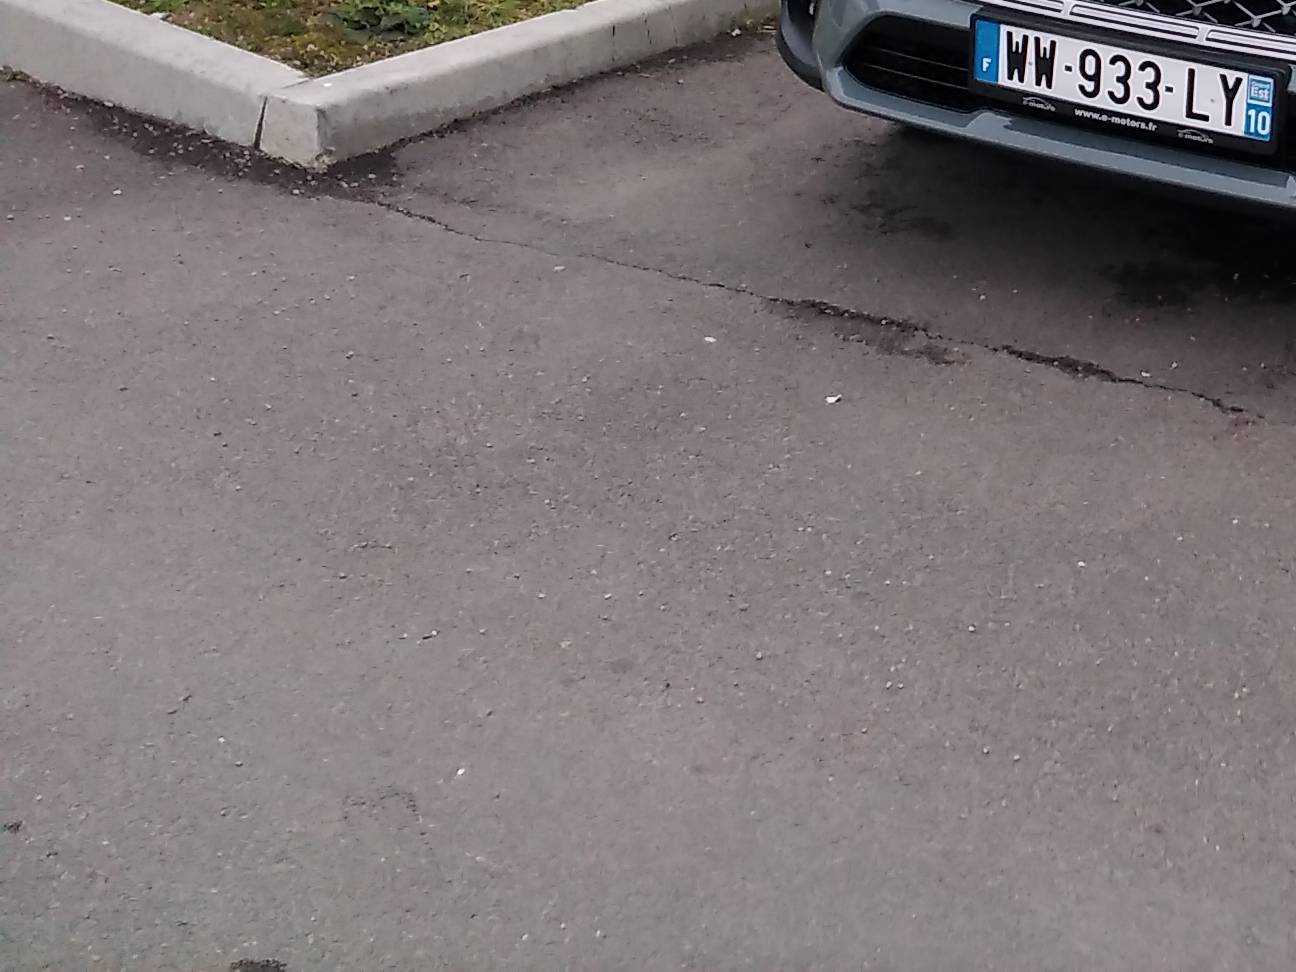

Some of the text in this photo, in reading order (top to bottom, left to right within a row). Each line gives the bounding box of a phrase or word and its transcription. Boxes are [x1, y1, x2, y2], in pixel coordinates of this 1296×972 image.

[982, 57, 992, 72] F
[1005, 30, 1244, 127] WW-933-LY
[1251, 85, 1269, 99] Est
[1074, 107, 1158, 132] www.e-motors.fr
[1248, 108, 1270, 135] 10
